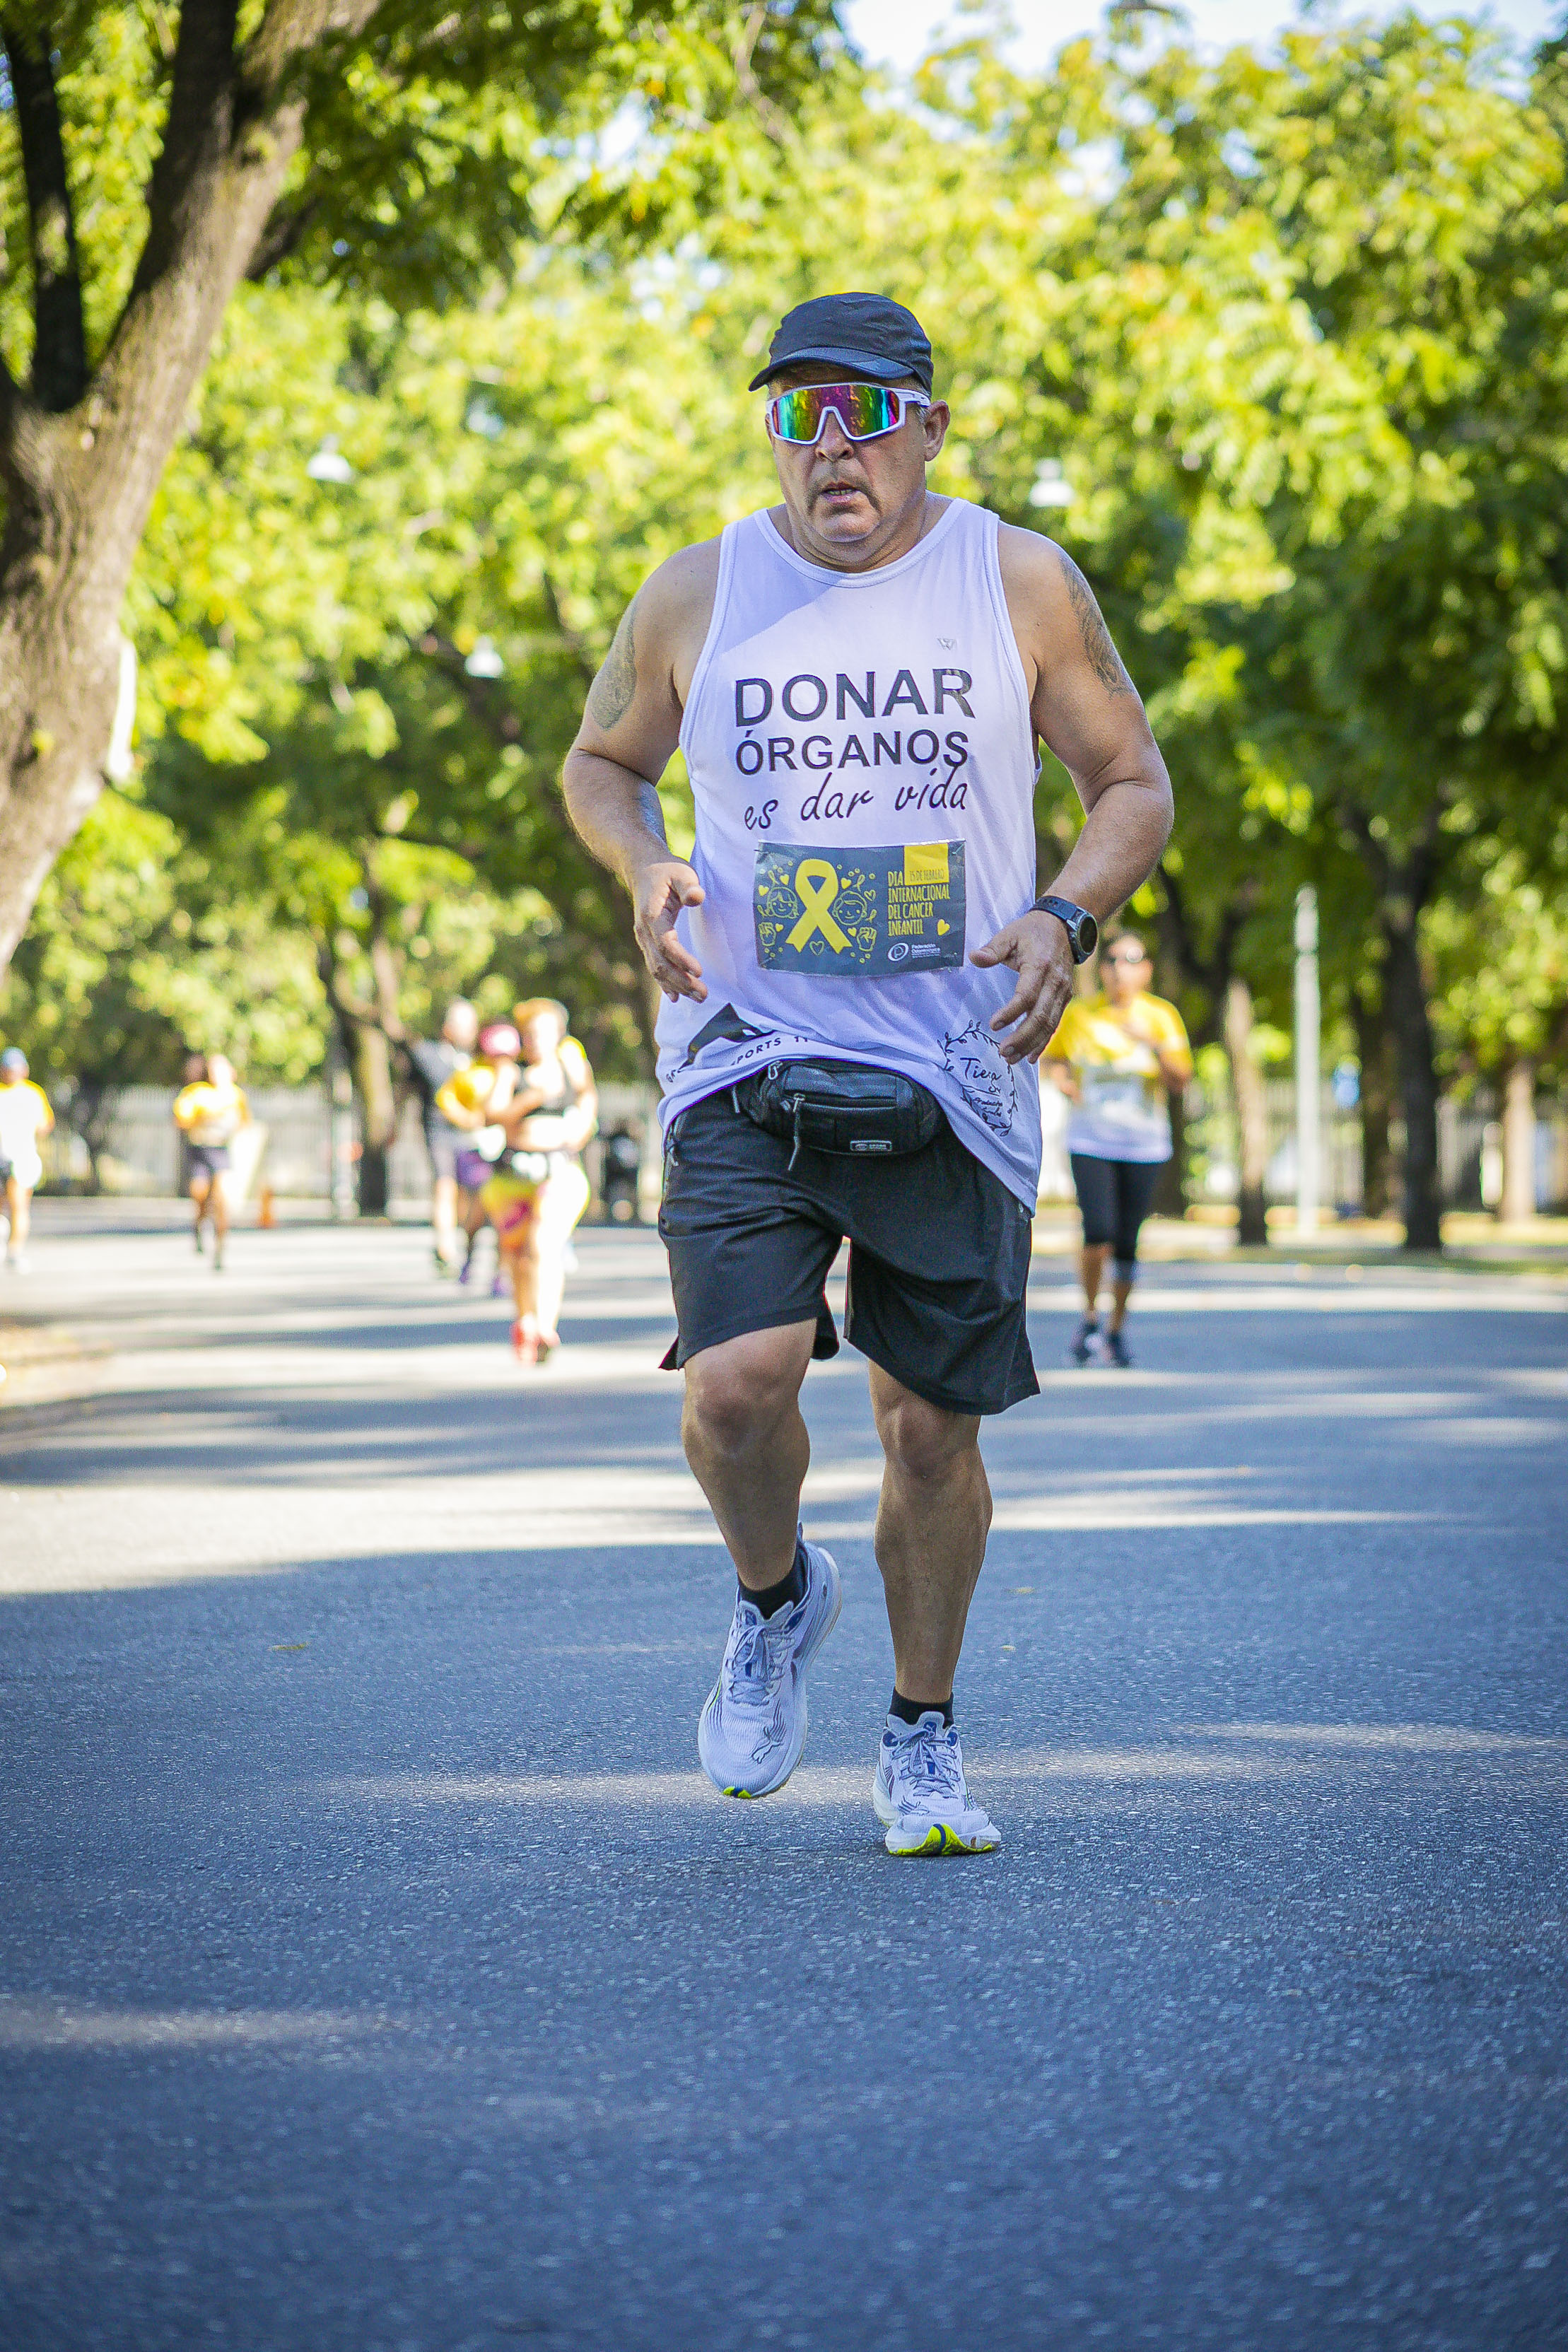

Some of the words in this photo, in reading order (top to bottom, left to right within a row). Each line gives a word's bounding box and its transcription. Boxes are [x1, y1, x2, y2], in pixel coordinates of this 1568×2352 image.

[735, 668, 976, 727] DONAR
[735, 729, 969, 776] ÓRGANOS
[744, 799, 778, 831] es
[800, 771, 874, 821] dar
[894, 766, 968, 811] vida
[887, 870, 903, 887] DIA
[888, 884, 950, 903] INTERNACIONAL
[888, 903, 901, 920] DEL
[903, 901, 933, 919] CANCER
[888, 919, 924, 937] INFANTIL
